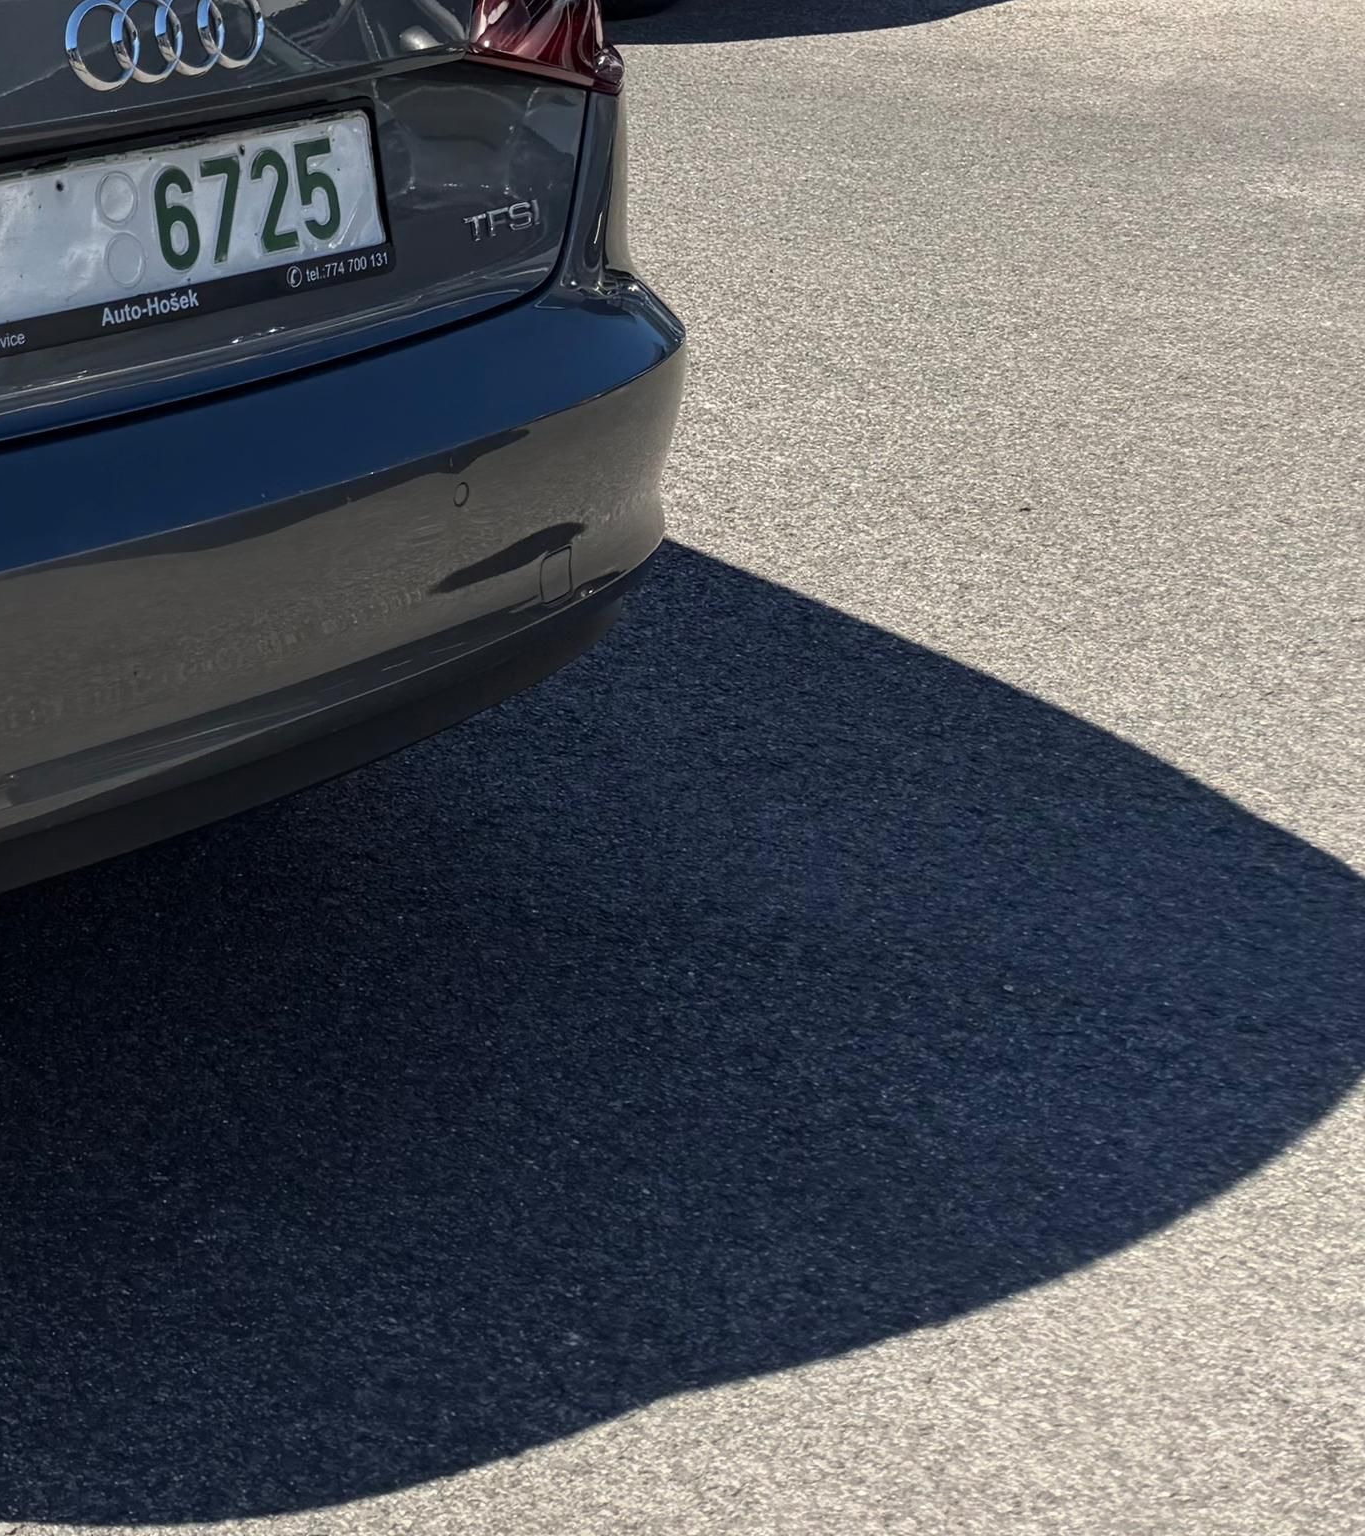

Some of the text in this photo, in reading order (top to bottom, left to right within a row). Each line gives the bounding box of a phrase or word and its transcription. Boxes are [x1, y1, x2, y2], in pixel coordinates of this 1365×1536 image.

[153, 136, 341, 272] 6725
[462, 199, 540, 242] TFSI
[347, 255, 368, 273] 700
[370, 251, 389, 268] 131
[101, 288, 200, 327] Auto-Hošek
